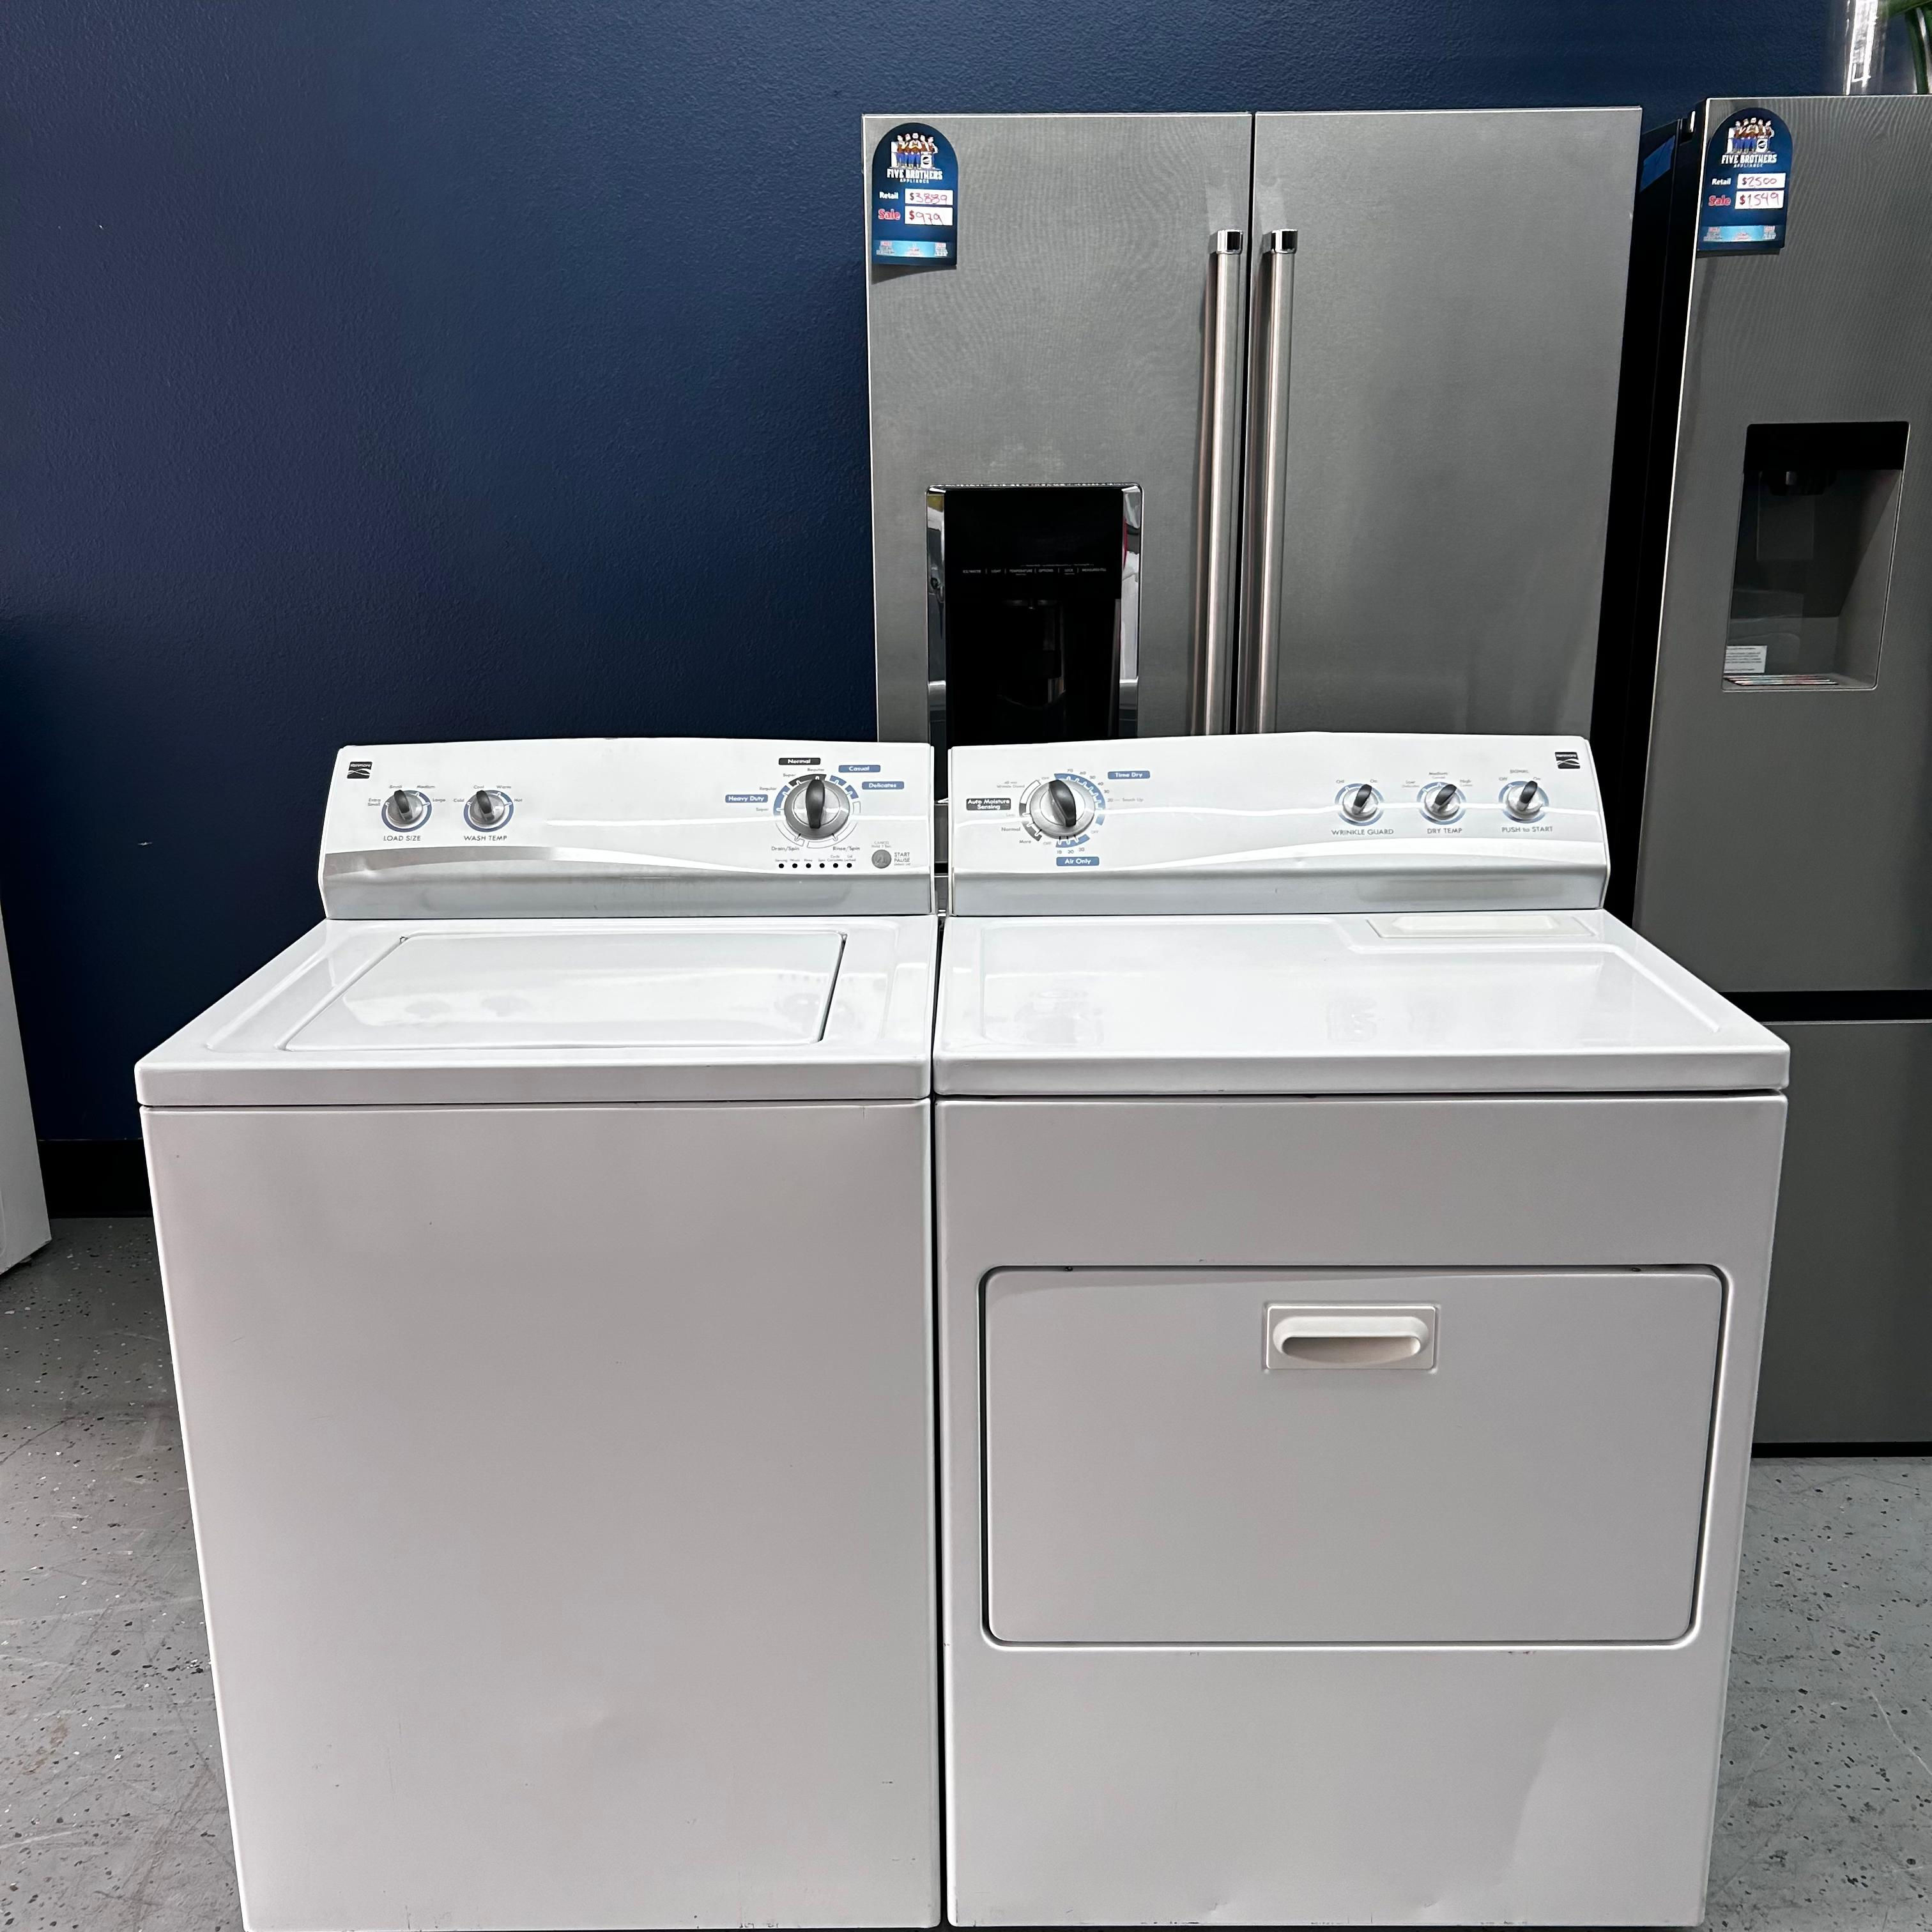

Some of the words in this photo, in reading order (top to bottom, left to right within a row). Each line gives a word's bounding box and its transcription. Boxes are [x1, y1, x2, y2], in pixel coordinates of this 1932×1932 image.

[1721, 155, 1739, 164] FIVE
[1740, 154, 1777, 164] BROTHERS
[887, 168, 904, 178] FIVE
[905, 169, 943, 180] BROTHERS
[1712, 178, 1731, 186] Retail
[1742, 177, 1777, 188] $2500
[1708, 195, 1731, 206] Sale
[1739, 192, 1779, 206] $1549
[878, 209, 901, 220] Sale
[909, 210, 944, 225] $979
